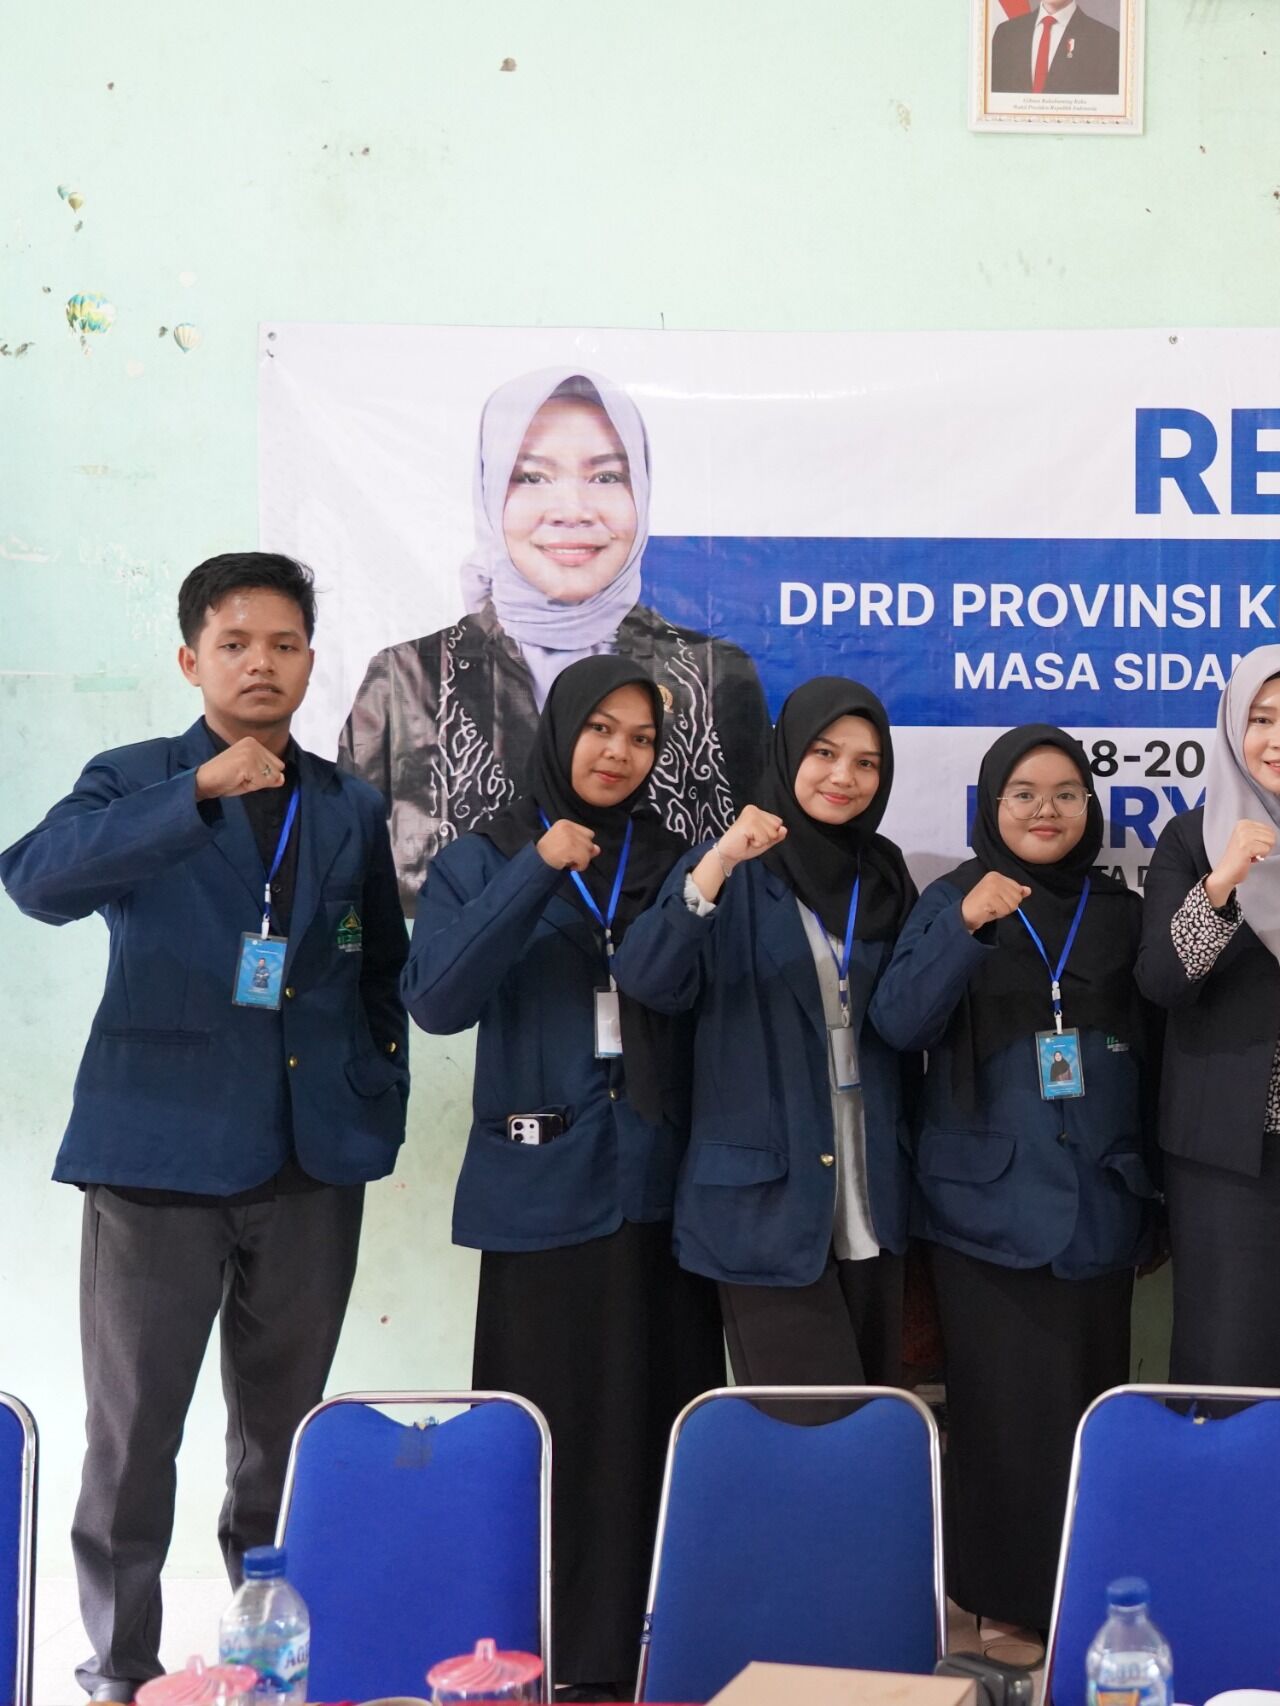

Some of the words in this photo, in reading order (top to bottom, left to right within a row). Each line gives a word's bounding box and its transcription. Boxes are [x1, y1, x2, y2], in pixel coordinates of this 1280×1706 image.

[780, 581, 935, 626] DPRD
[953, 582, 1222, 629] PROVINSI
[954, 651, 1100, 691] MASA
[1113, 652, 1243, 692] SIDA
[1074, 739, 1206, 778] 8-20
